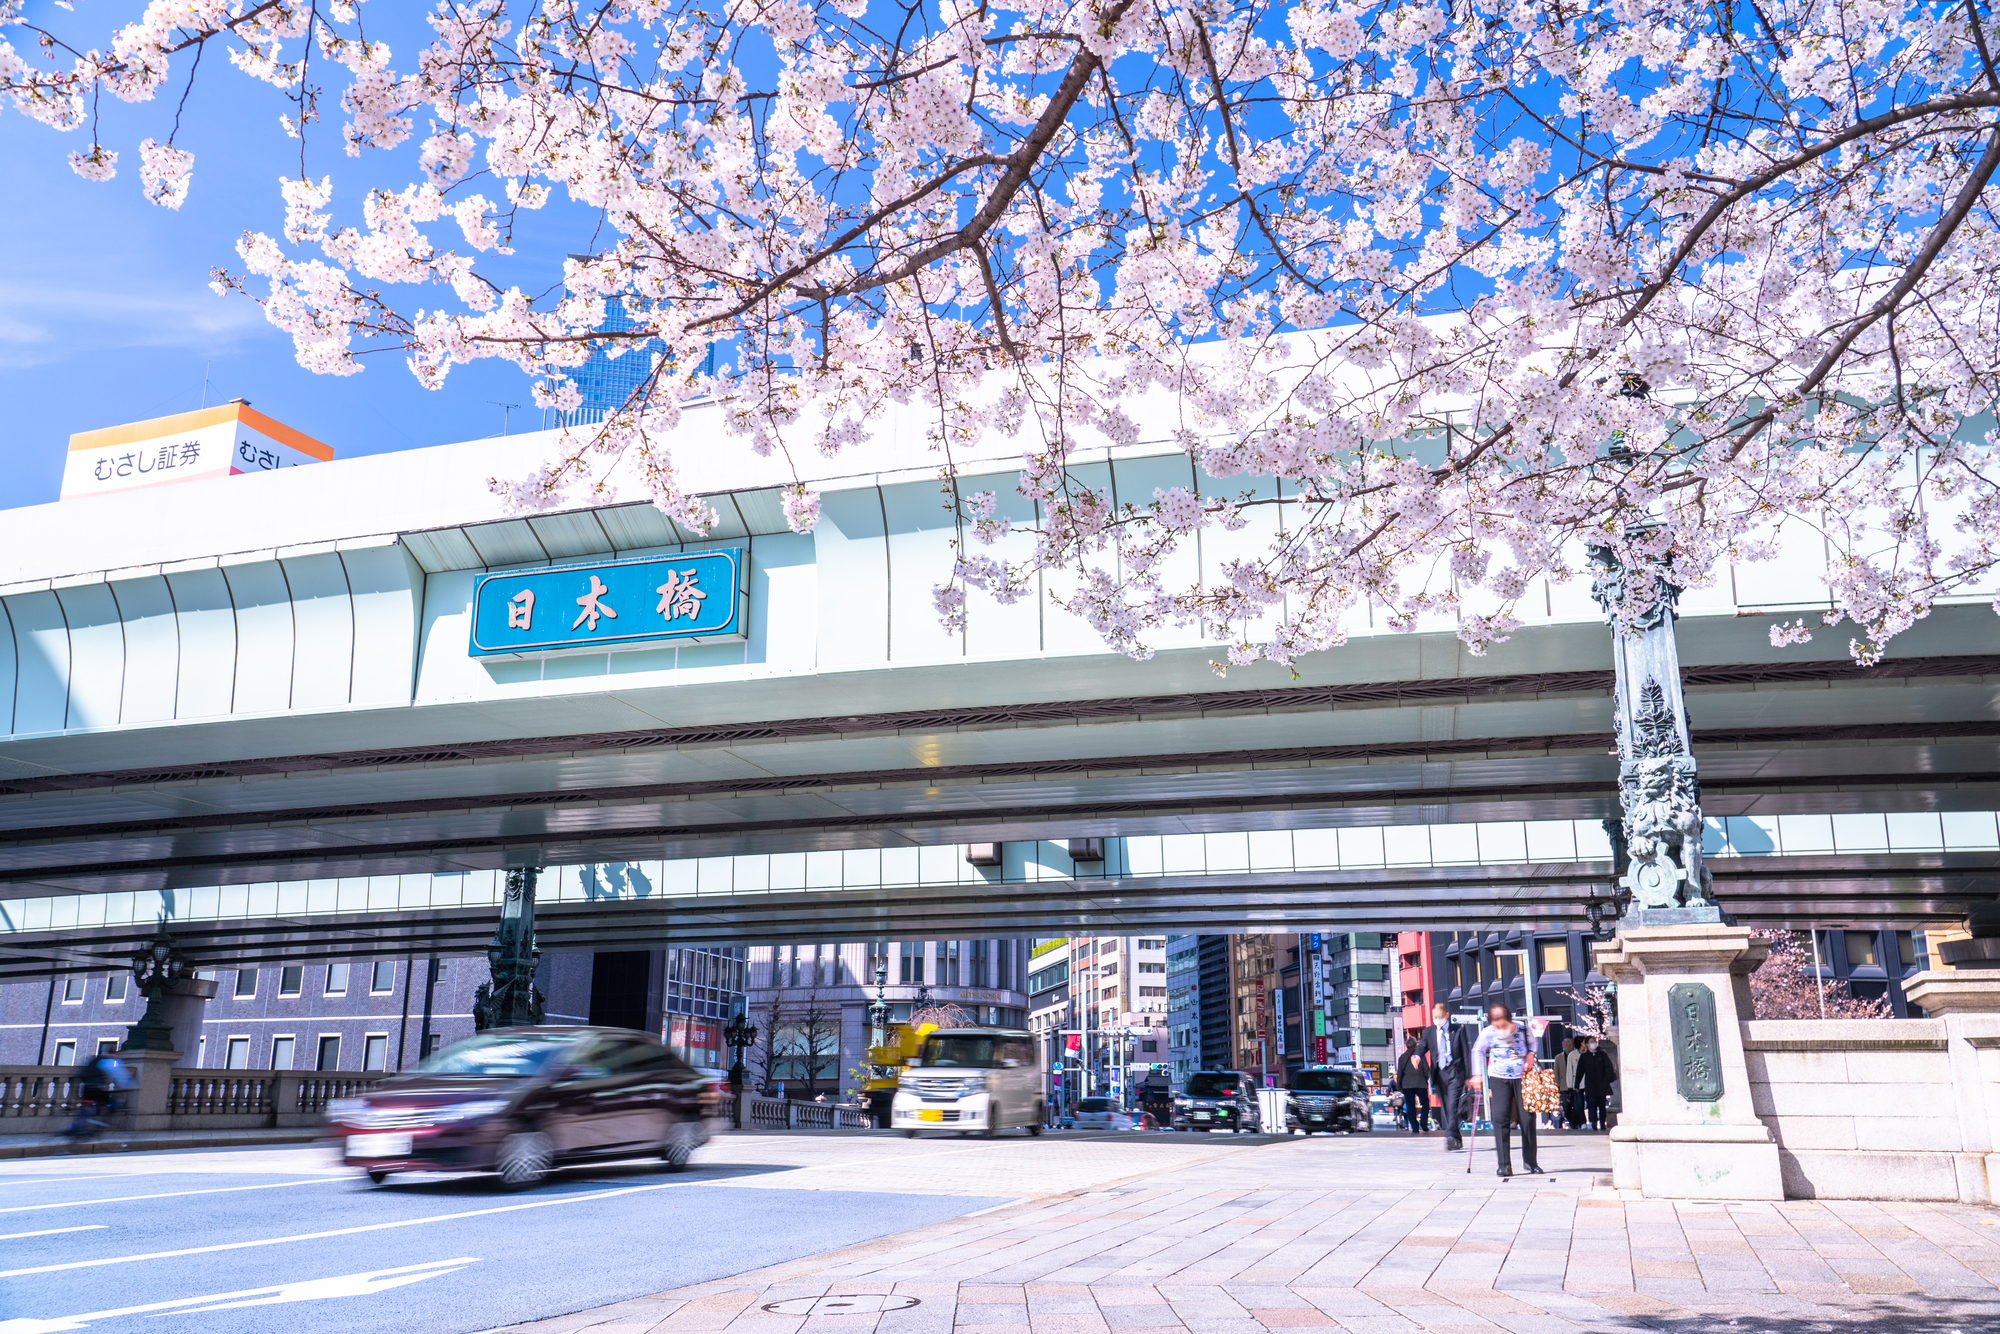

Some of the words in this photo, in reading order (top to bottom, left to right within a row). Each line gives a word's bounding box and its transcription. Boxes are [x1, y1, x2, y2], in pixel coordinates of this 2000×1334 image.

[94, 440, 201, 480] むさし証券
[507, 568, 707, 631] 日本橋
[959, 991, 1002, 1000] MITSUKOSHI
[1190, 999, 1200, 1064] 山本海苔店
[1684, 1002, 1711, 1080] 日本橋
